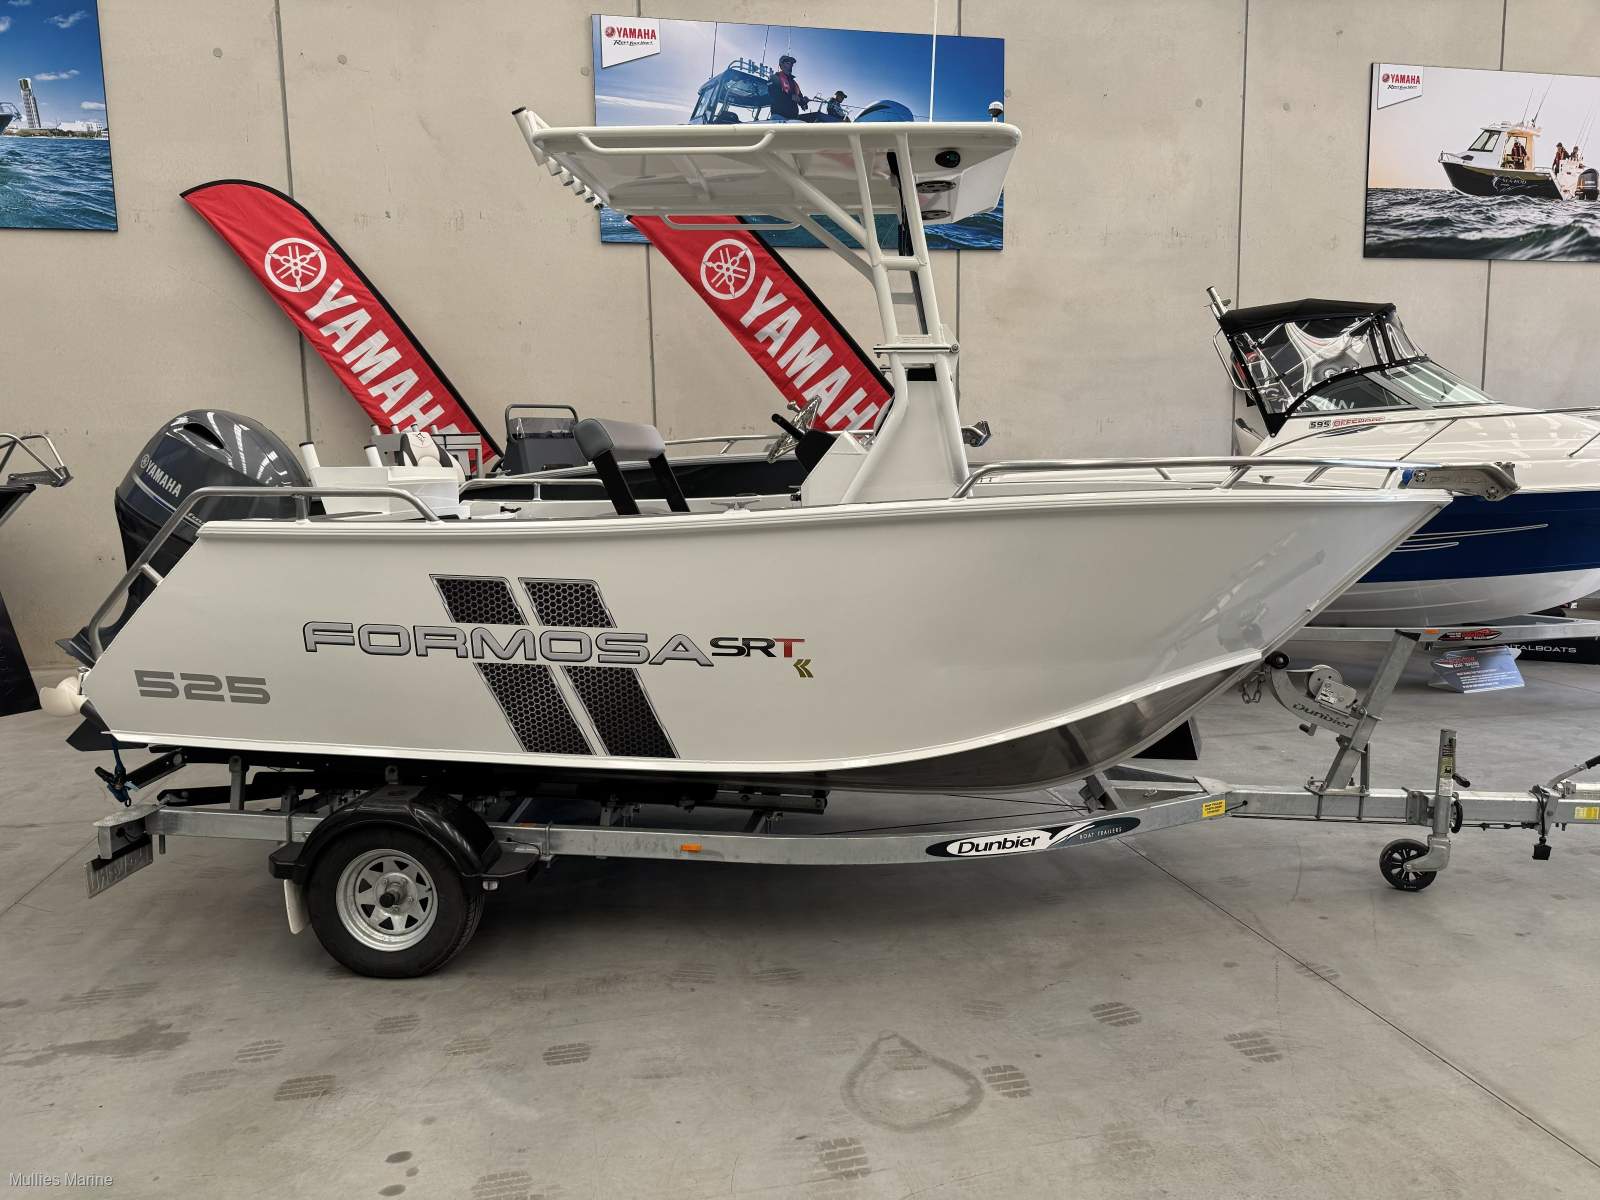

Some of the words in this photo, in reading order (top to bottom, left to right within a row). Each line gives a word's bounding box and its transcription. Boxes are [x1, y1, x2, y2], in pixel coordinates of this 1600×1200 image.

[616, 26, 657, 40] YAMAHA
[1390, 73, 1421, 85] YAMAHA
[305, 278, 462, 433] YAMAH
[1309, 419, 1332, 429] 595
[145, 459, 182, 498] YAMAHA
[303, 621, 715, 667] FORMOSA
[709, 636, 806, 659] SRT
[134, 669, 271, 705] 525
[957, 834, 1041, 855] Dunbier
[1080, 832, 1095, 840] BOAT
[1097, 827, 1123, 837] TRAILERS
